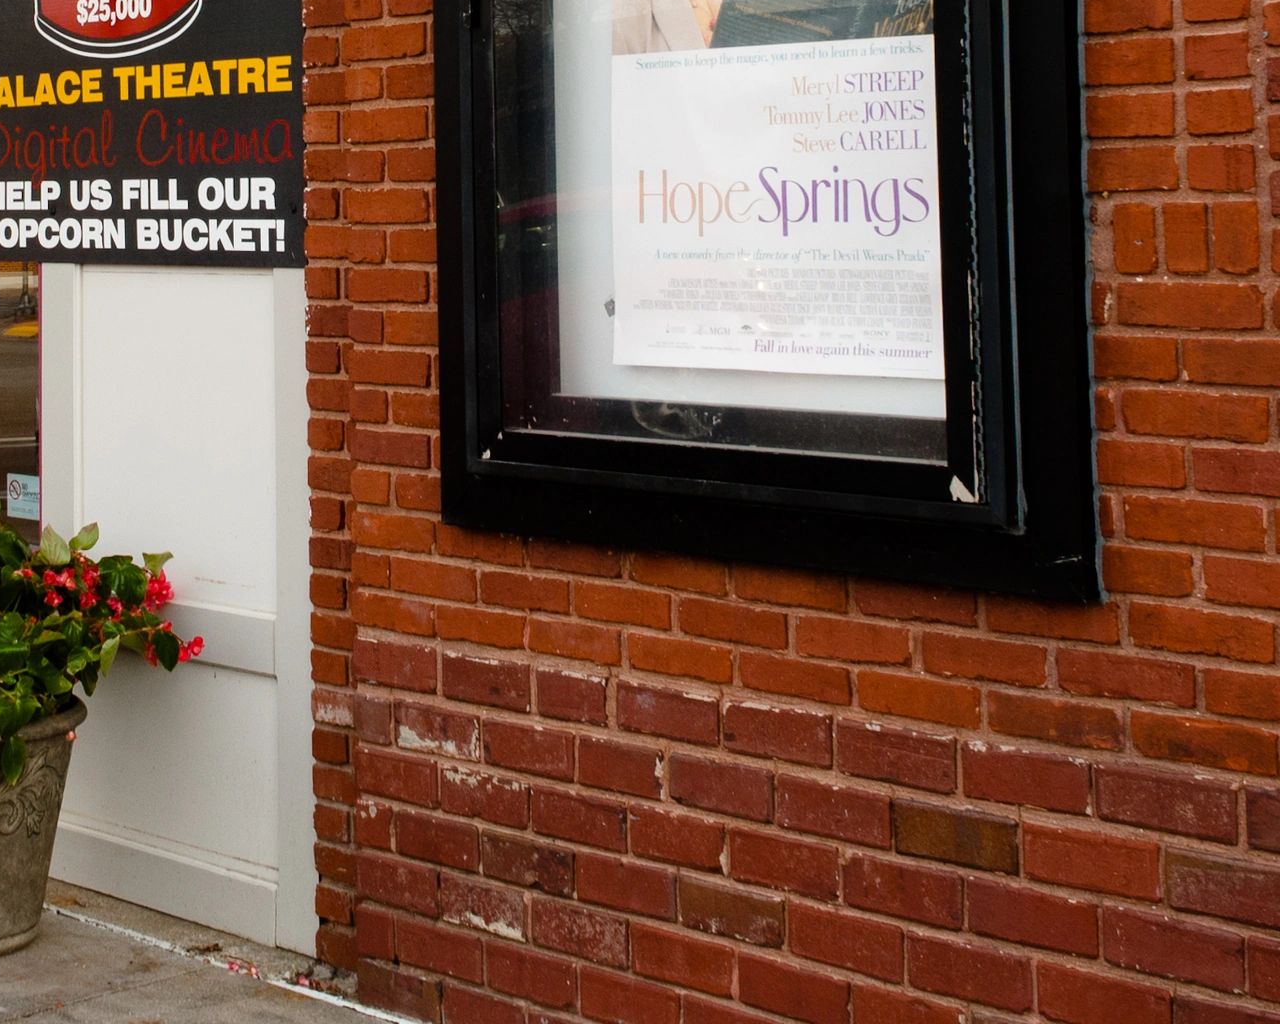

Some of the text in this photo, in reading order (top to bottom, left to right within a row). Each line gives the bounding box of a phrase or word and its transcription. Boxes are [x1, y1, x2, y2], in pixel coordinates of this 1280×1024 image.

[635, 56, 682, 71] Sometimes
[684, 57, 693, 68] to
[695, 54, 718, 69] keep
[720, 52, 734, 65] the
[770, 51, 788, 64] you
[790, 46, 816, 61] need
[818, 47, 829, 59] to
[831, 45, 858, 58] learn
[860, 48, 867, 57] a
[870, 43, 887, 56] few
[119, 55, 293, 100] THEATRE
[792, 70, 925, 100] Meryl STREEP
[763, 99, 926, 130] Tommy Lee JONES
[136, 108, 295, 166] Cinema
[792, 129, 928, 153] Steve CARELL
[70, 178, 113, 212] US
[121, 178, 188, 211] FILL
[197, 176, 276, 211] OUR
[136, 218, 286, 253] BUCKET!
[833, 248, 860, 262] Devil
[862, 249, 894, 262] Wears
[754, 338, 775, 354] Fall
[777, 340, 788, 354] in
[790, 340, 814, 354] love
[815, 342, 850, 359] again
[852, 343, 876, 357] this
[879, 347, 933, 360] summer
